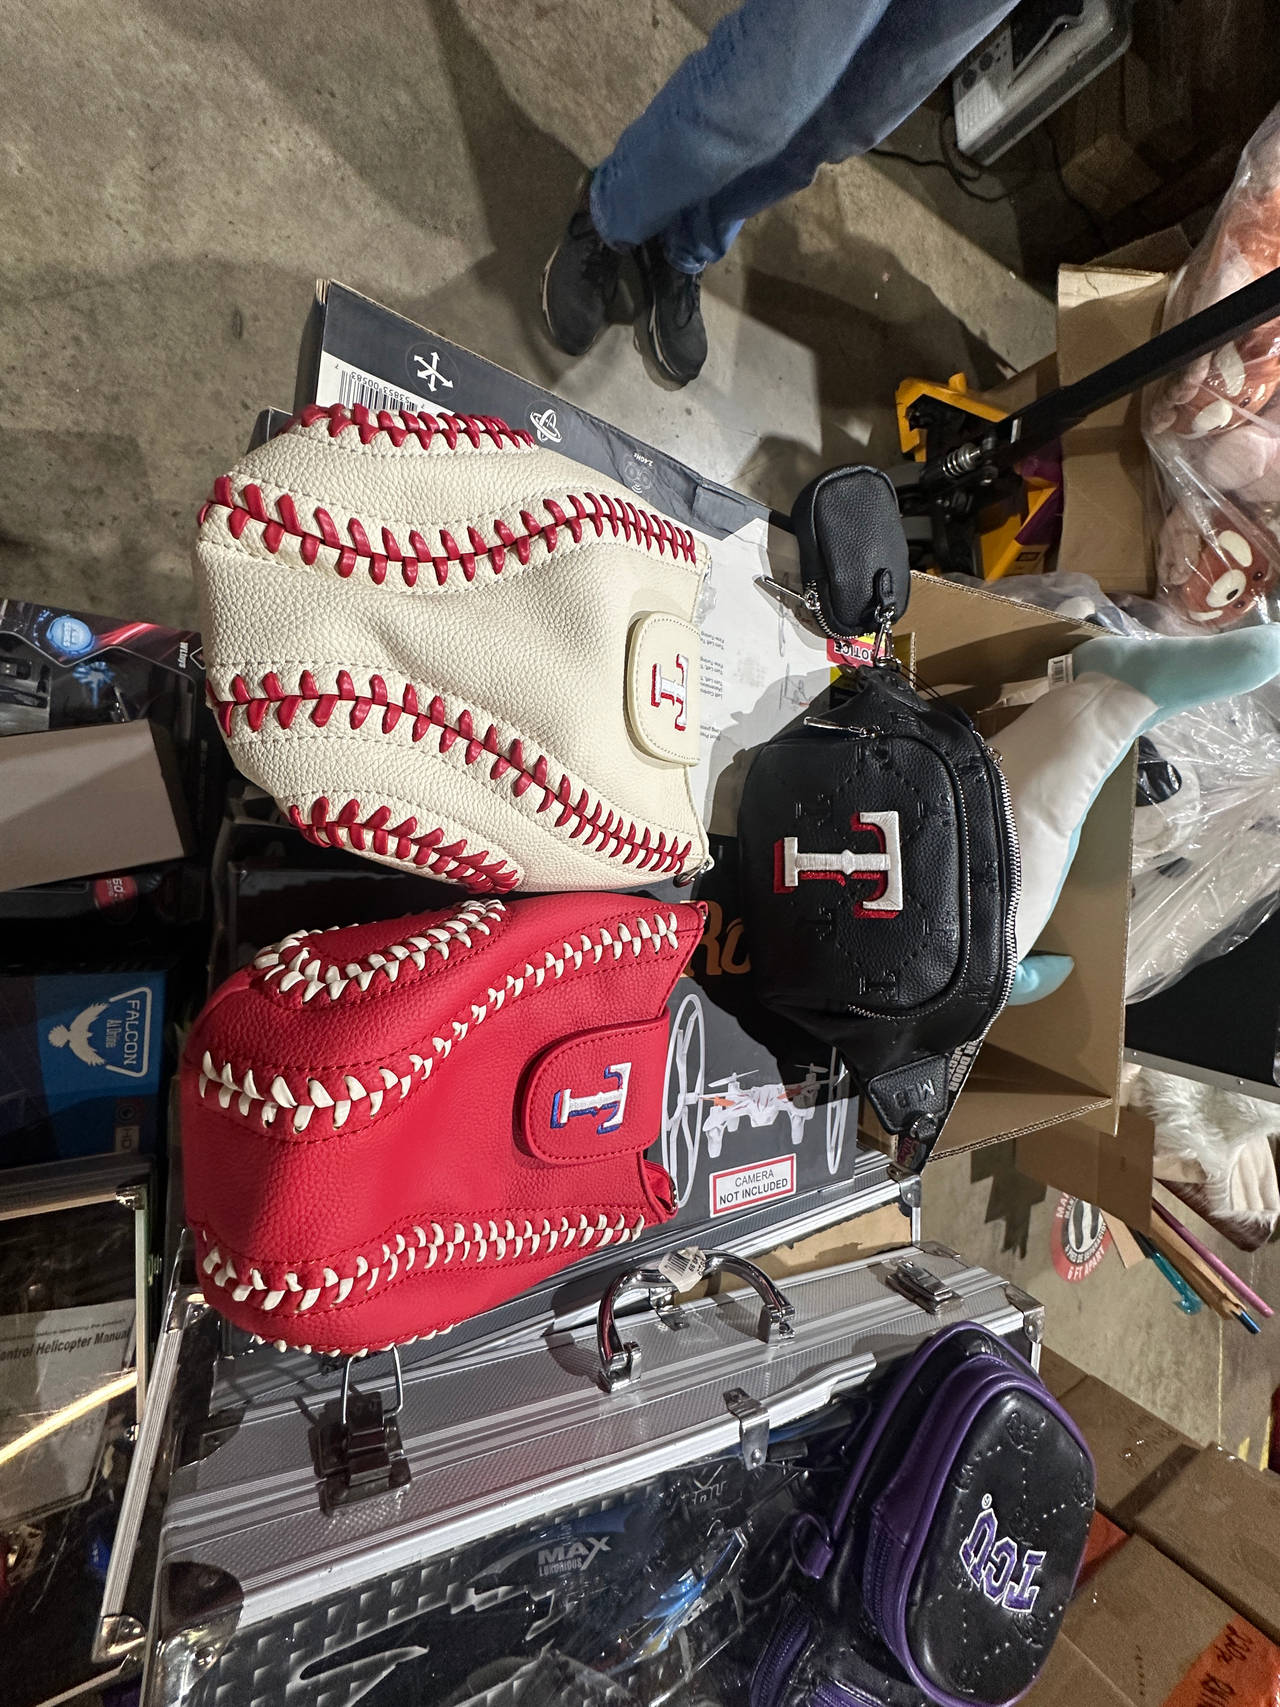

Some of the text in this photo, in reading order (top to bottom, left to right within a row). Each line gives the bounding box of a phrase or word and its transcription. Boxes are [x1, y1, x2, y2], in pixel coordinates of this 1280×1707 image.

[351, 372, 379, 390] 00583
[383, 386, 411, 403] 53853
[633, 452, 653, 466] 2.4GHz
[178, 642, 189, 669] WLtoys
[835, 642, 871, 662] OTICE
[651, 653, 689, 732] T
[773, 811, 903, 919] T
[123, 999, 141, 1066] FALCON
[949, 1055, 971, 1092] DOOR
[550, 1062, 632, 1135] T
[719, 1177, 788, 1205] NOT INCLUDED
[735, 1168, 775, 1188] CAMERA
[1073, 1265, 1083, 1281] FT
[1084, 1245, 1105, 1277] APART
[0, 1344, 35, 1361] ontrol
[36, 1336, 92, 1356] Helicopter
[94, 1328, 131, 1345] Manual
[537, 1536, 612, 1571] MAX
[959, 1508, 1047, 1613] TCU
